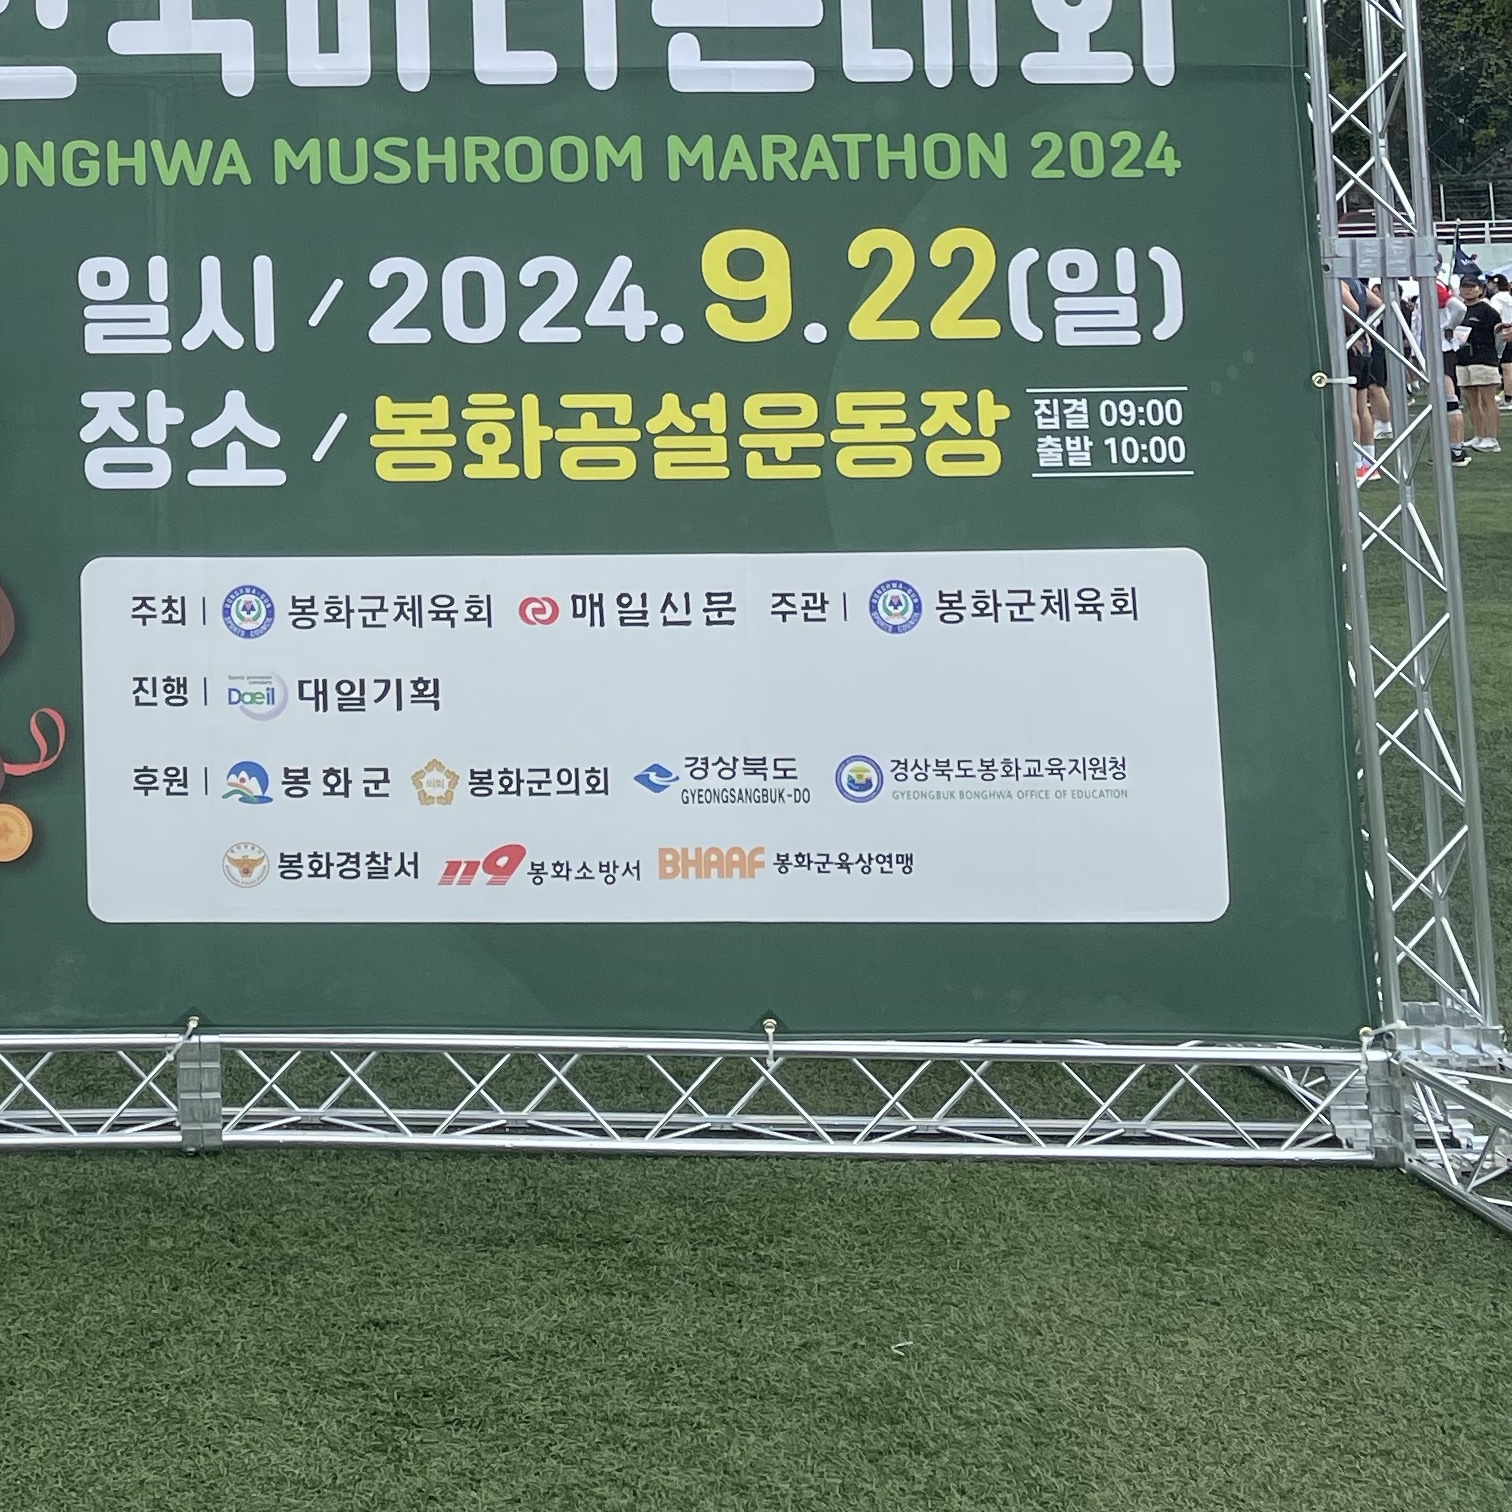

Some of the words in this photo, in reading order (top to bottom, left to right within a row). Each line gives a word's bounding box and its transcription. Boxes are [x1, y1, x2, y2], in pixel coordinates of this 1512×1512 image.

[274, 135, 642, 185] MUSHROOM
[667, 132, 1007, 181] MARATHON
[1031, 131, 1181, 179] 2024
[78, 255, 274, 354] 일시
[1034, 398, 1090, 430] 집결
[1100, 399, 1183, 426] 09:00
[80, 390, 286, 489] 장소
[370, 389, 1010, 481] 봉화공설운동장
[1037, 435, 1094, 467] 출발
[1105, 436, 1186, 464] 10:00
[131, 595, 187, 626] 주최
[288, 595, 493, 629] 봉화군체육회
[571, 592, 737, 628] 매일신문
[770, 591, 830, 623] 주관
[936, 586, 1139, 624] 봉화군체육회
[132, 676, 189, 707] 진행
[228, 687, 275, 705] Daeil
[298, 677, 440, 712] 대일기획
[133, 766, 188, 796] 후원
[282, 766, 391, 799] 봉화군
[468, 767, 609, 797] 봉화군의회
[684, 755, 798, 782] 경상북도
[890, 756, 1127, 783] 경상북도봉화교육지원청
[681, 788, 810, 805] GYEONGSANGBUK-DO
[892, 790, 956, 800] GYEONGBUK
[959, 790, 1013, 800] BONGHWA
[1017, 790, 1050, 800] OFFICE
[1054, 790, 1068, 799] OF
[1071, 789, 1128, 799] EDUCATION
[277, 851, 419, 880] 봉화경찰서
[437, 844, 527, 886] 119
[527, 860, 641, 886] 봉화소방서
[657, 846, 766, 881] BHAAF
[773, 851, 914, 876] 봉화군육상연맹
